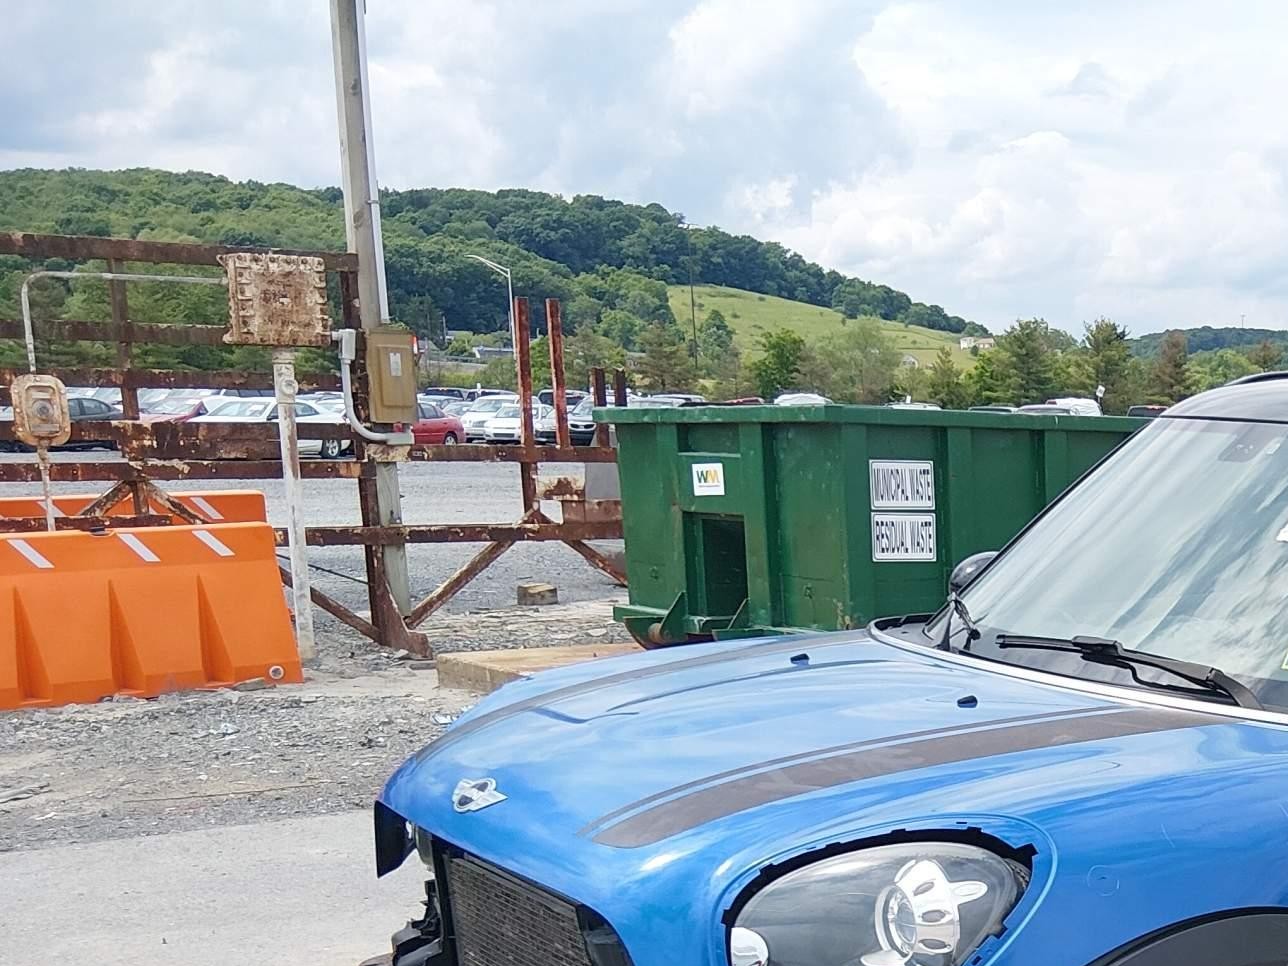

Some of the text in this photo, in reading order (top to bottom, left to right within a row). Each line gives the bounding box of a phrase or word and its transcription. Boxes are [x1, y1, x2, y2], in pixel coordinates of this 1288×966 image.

[873, 468, 932, 502] MUNICIPAL WASTE
[875, 521, 933, 554] RESIDUAL WASTE
